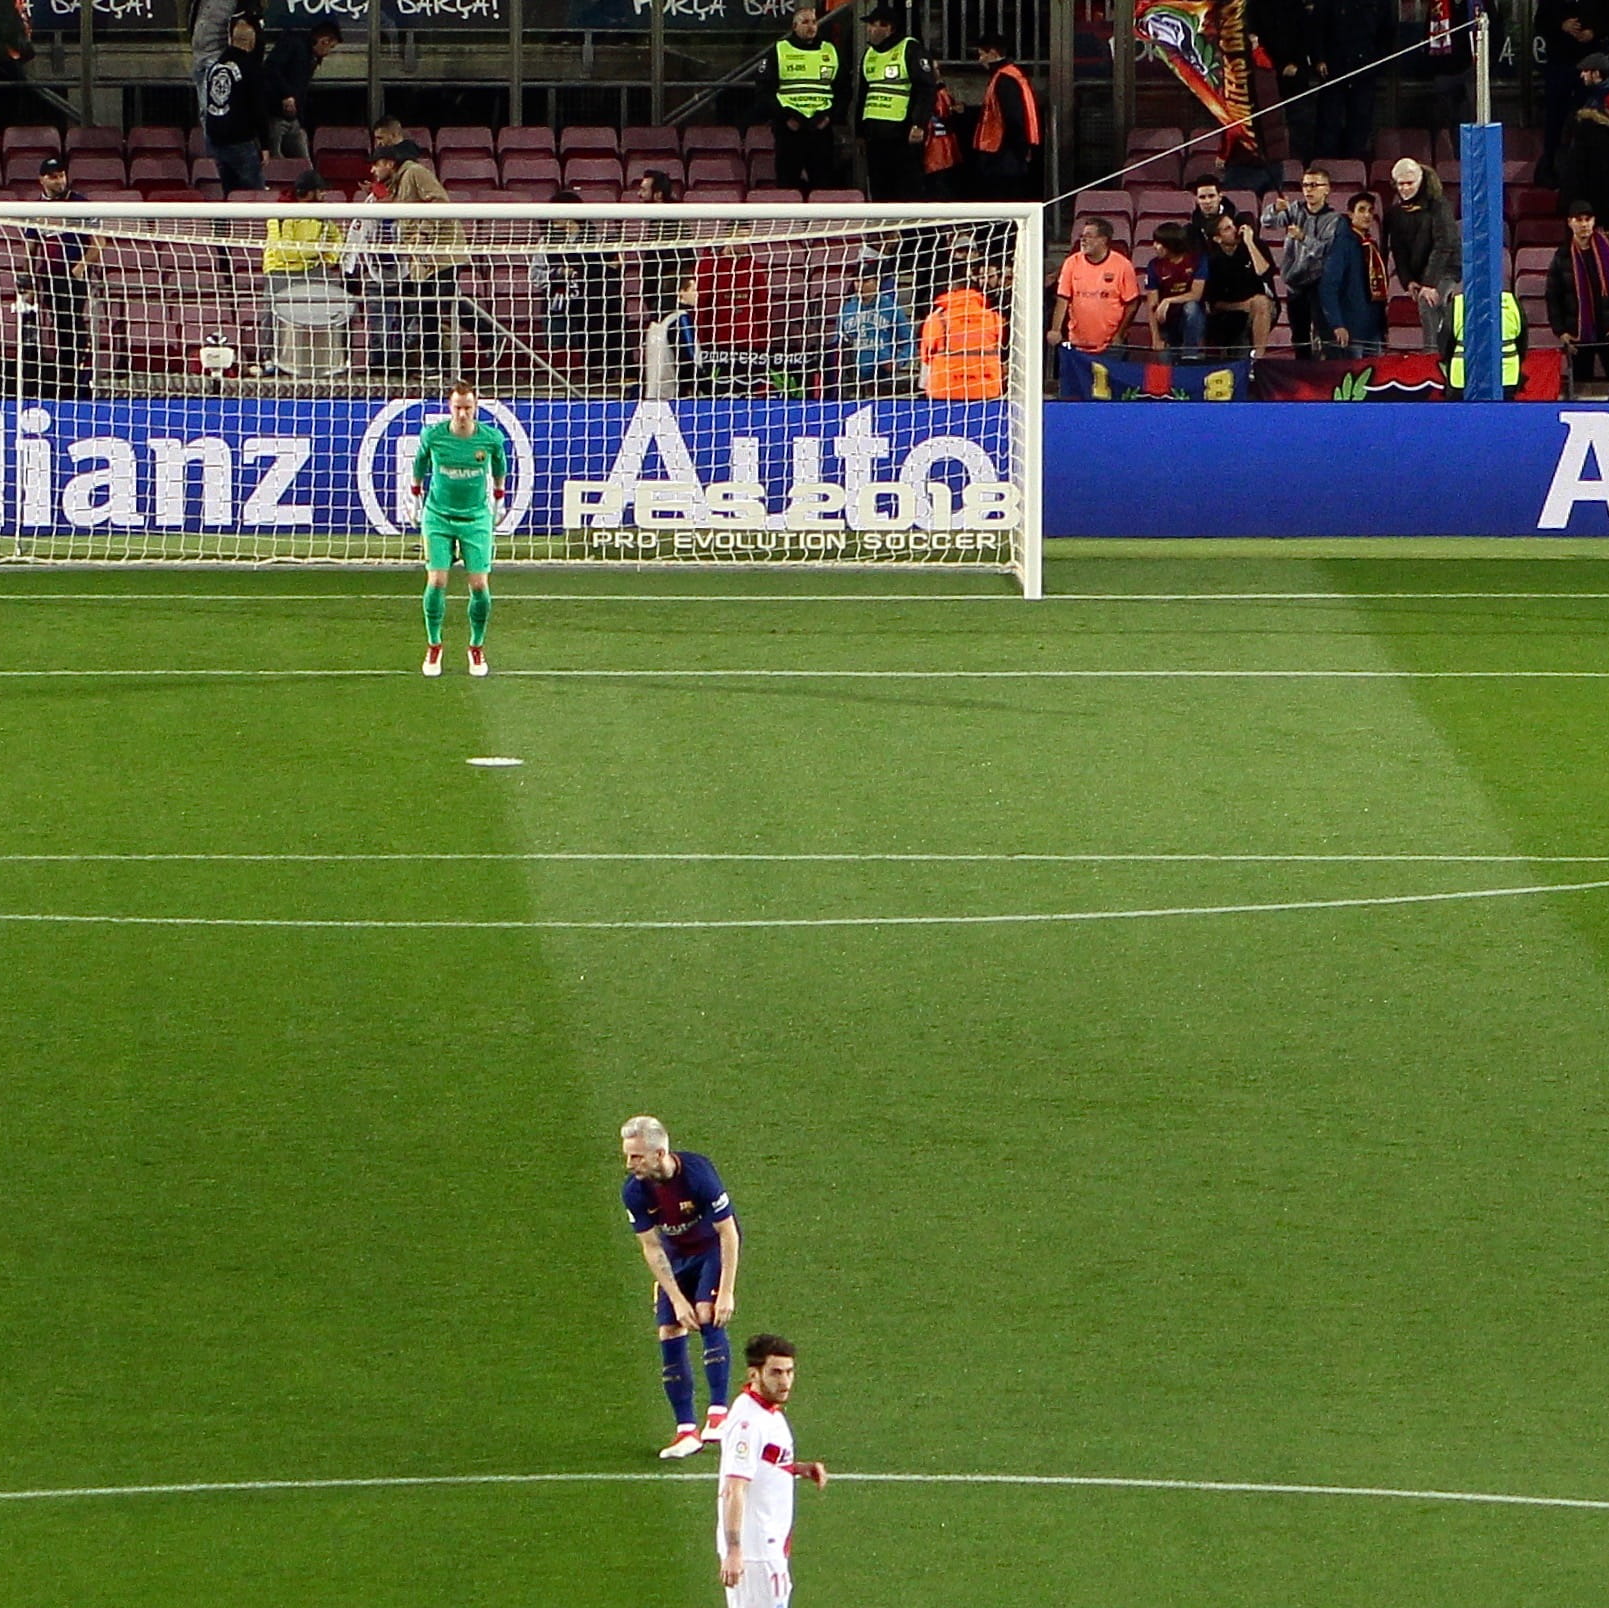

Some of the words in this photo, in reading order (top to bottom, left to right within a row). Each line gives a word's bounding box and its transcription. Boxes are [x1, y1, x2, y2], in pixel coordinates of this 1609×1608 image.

[591, 399, 1003, 531] Auto
[789, 482, 1021, 530] 2018
[592, 532, 658, 549] PRO
[674, 532, 847, 550] EVOLUTION
[863, 532, 997, 550] SOCCER
